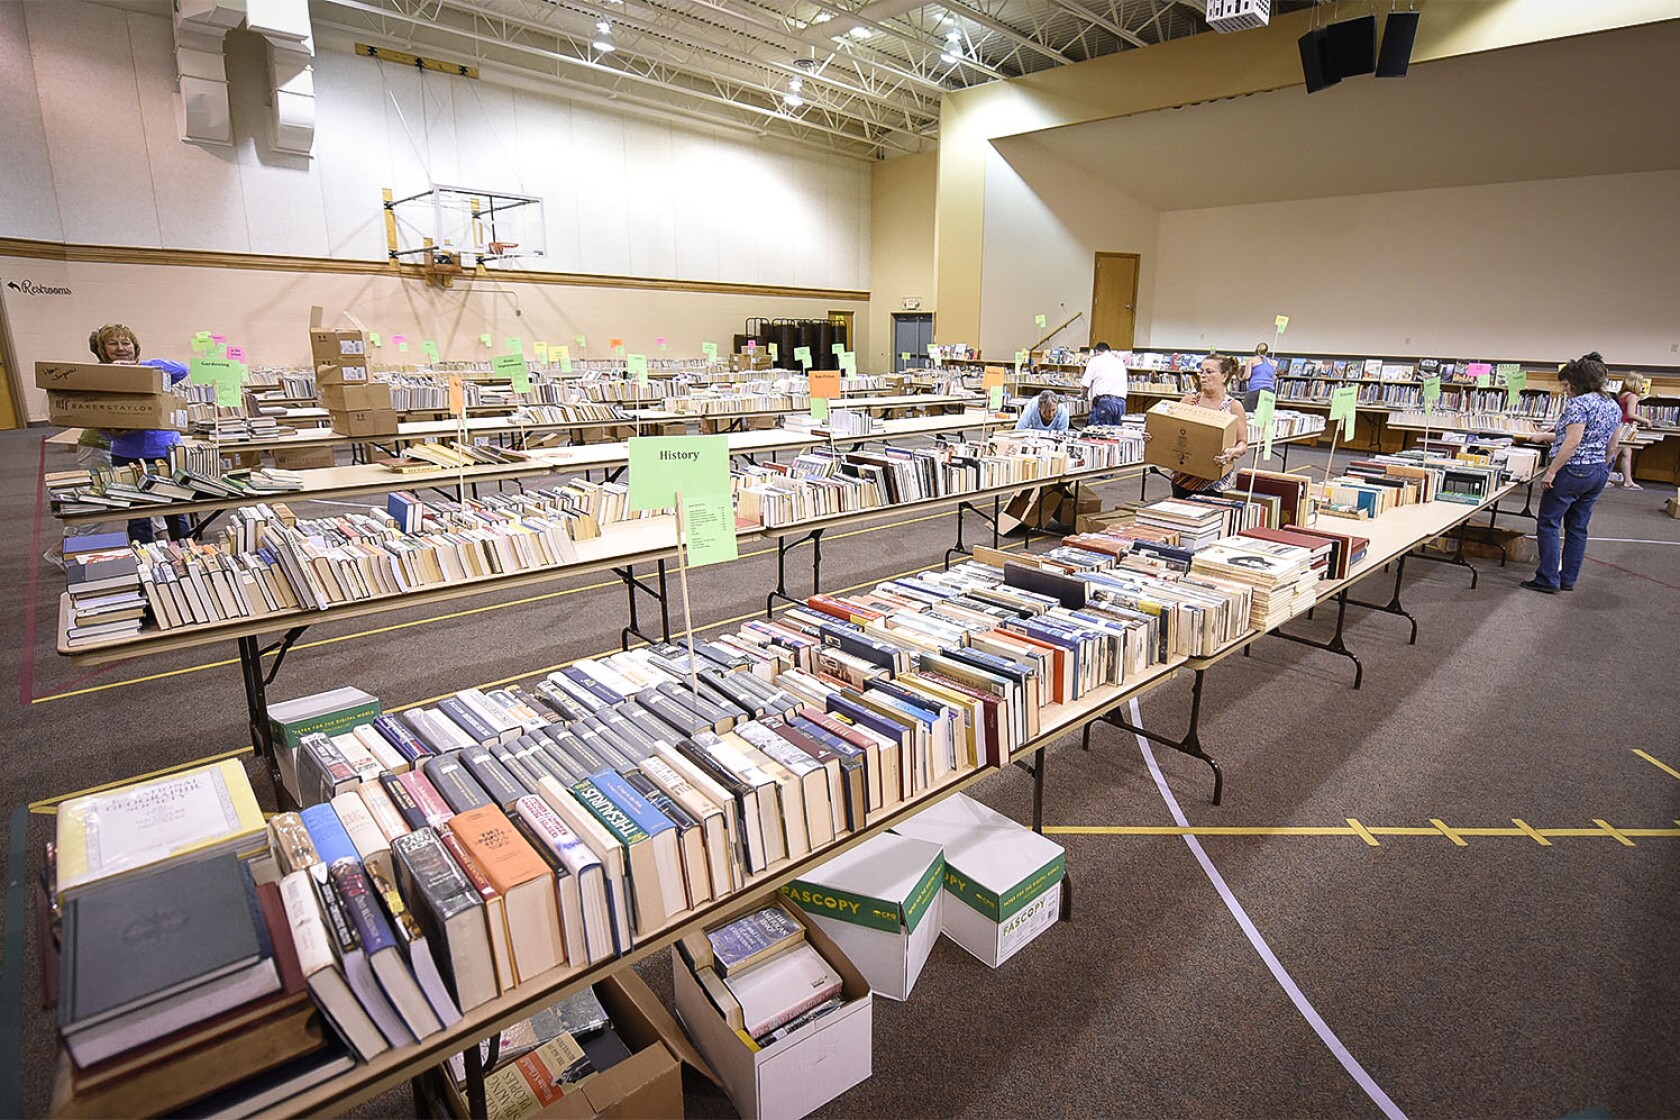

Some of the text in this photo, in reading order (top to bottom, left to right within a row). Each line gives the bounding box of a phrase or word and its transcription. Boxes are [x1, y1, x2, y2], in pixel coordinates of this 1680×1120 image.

[21, 280, 72, 296] Restrooms
[660, 450, 700, 462] History
[336, 715, 356, 724] DIGITAL
[357, 709, 375, 718] WORLD
[581, 788, 638, 837] THESAURUS
[779, 885, 861, 915] FASCOPY
[762, 910, 790, 936] AMERICAN
[774, 913, 787, 925] THE
[1002, 898, 1046, 938] FASCOPY
[487, 1076, 522, 1120] SPEAKING
[502, 1070, 533, 1111] PEOPLES
